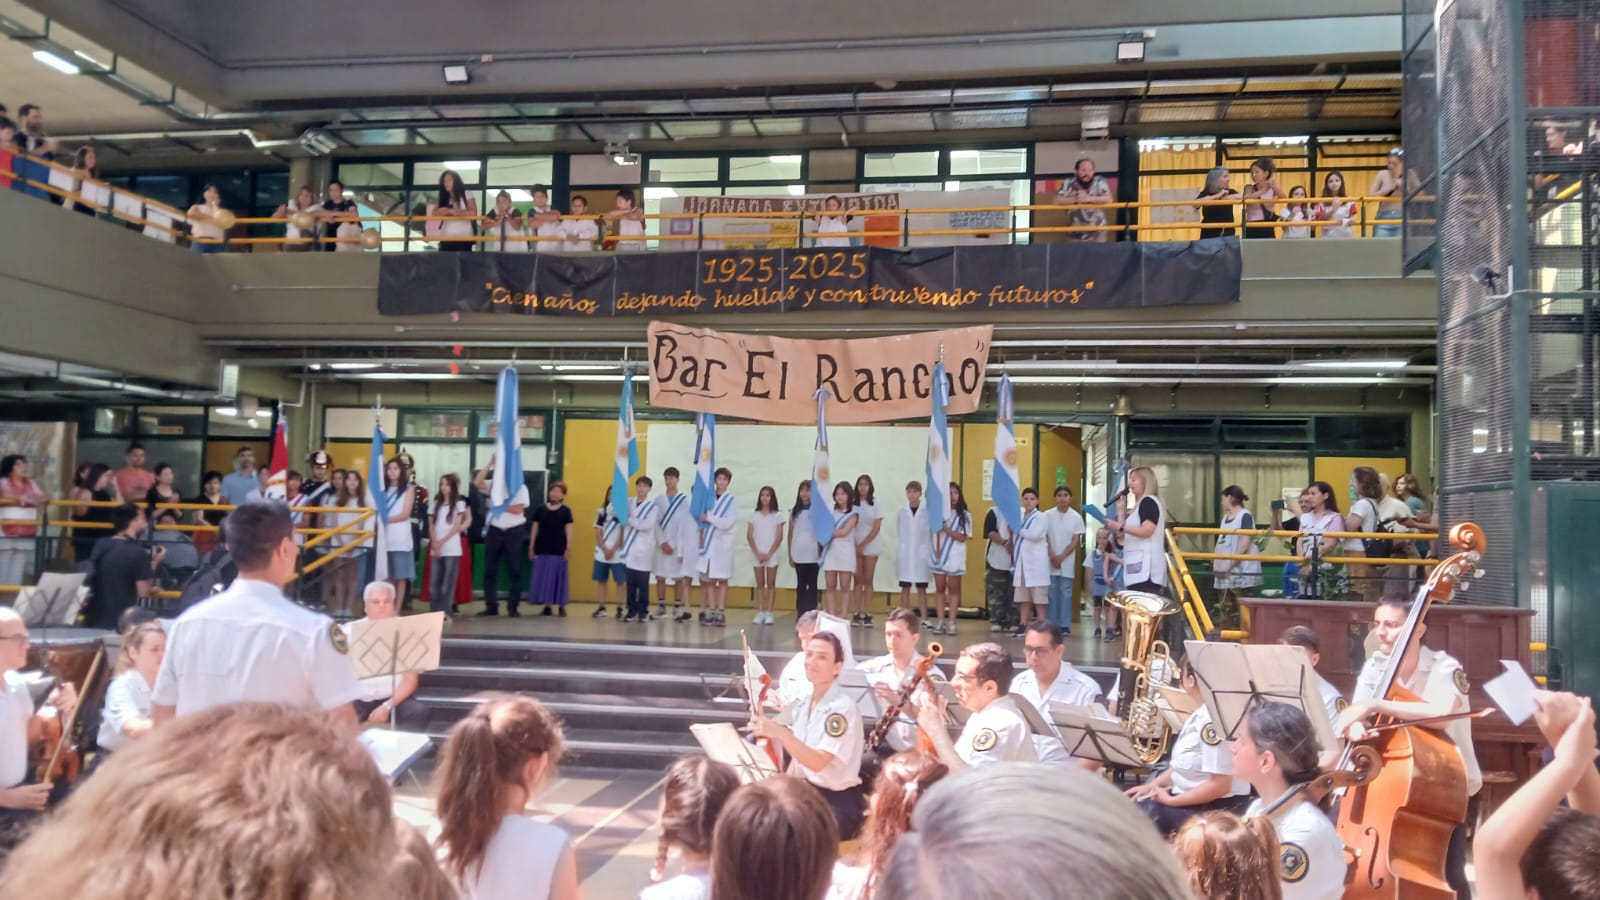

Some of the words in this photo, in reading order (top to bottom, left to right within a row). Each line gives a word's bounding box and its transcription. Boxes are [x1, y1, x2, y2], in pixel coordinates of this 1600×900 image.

[703, 252, 867, 284] 1925-2025
[544, 292, 599, 315] años
[616, 289, 707, 314] dejando
[713, 282, 801, 309] huellas
[801, 289, 817, 308] y
[819, 283, 983, 308] contruyendo
[653, 334, 727, 391] Bar
